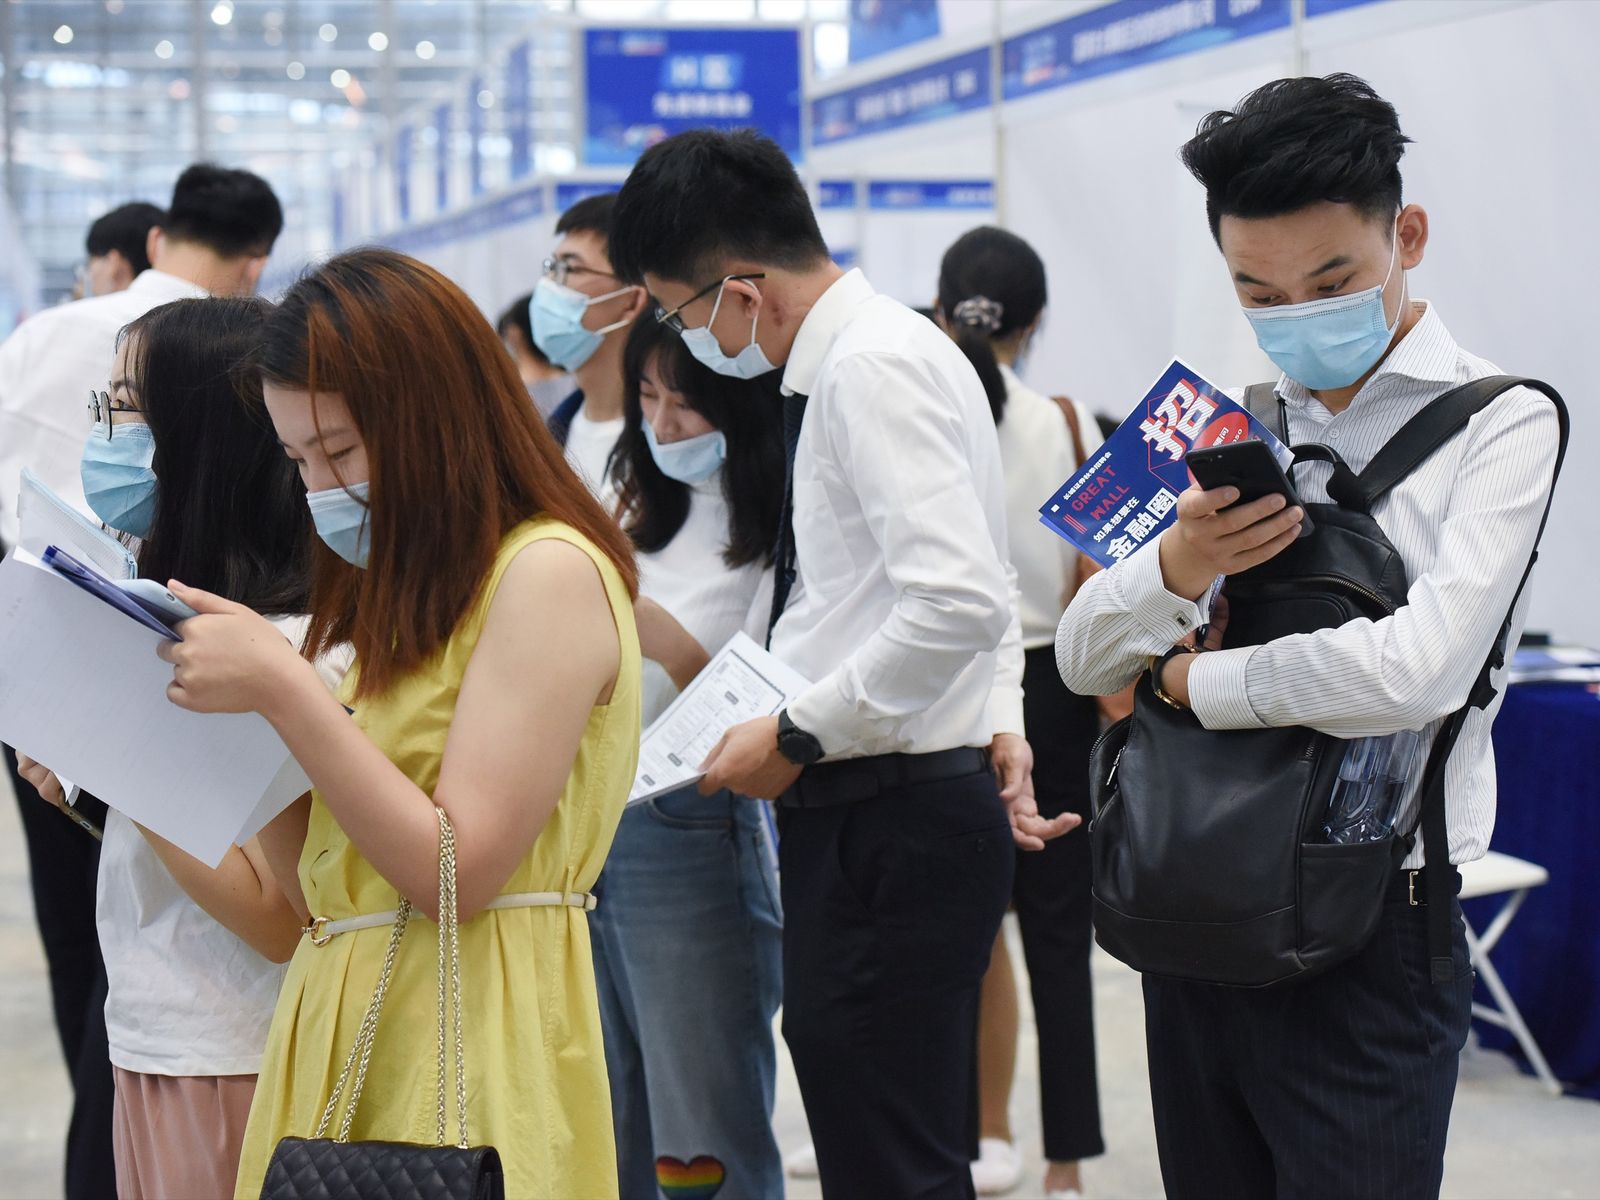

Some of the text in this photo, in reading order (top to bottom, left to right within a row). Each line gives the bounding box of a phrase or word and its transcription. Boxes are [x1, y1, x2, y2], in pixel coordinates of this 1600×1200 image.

[1138, 378, 1219, 462] 招
[1071, 464, 1117, 512] GREAT
[1089, 485, 1131, 521] WALL
[1093, 496, 1140, 543] 如果想要在
[1105, 487, 1179, 561] 金融圈
